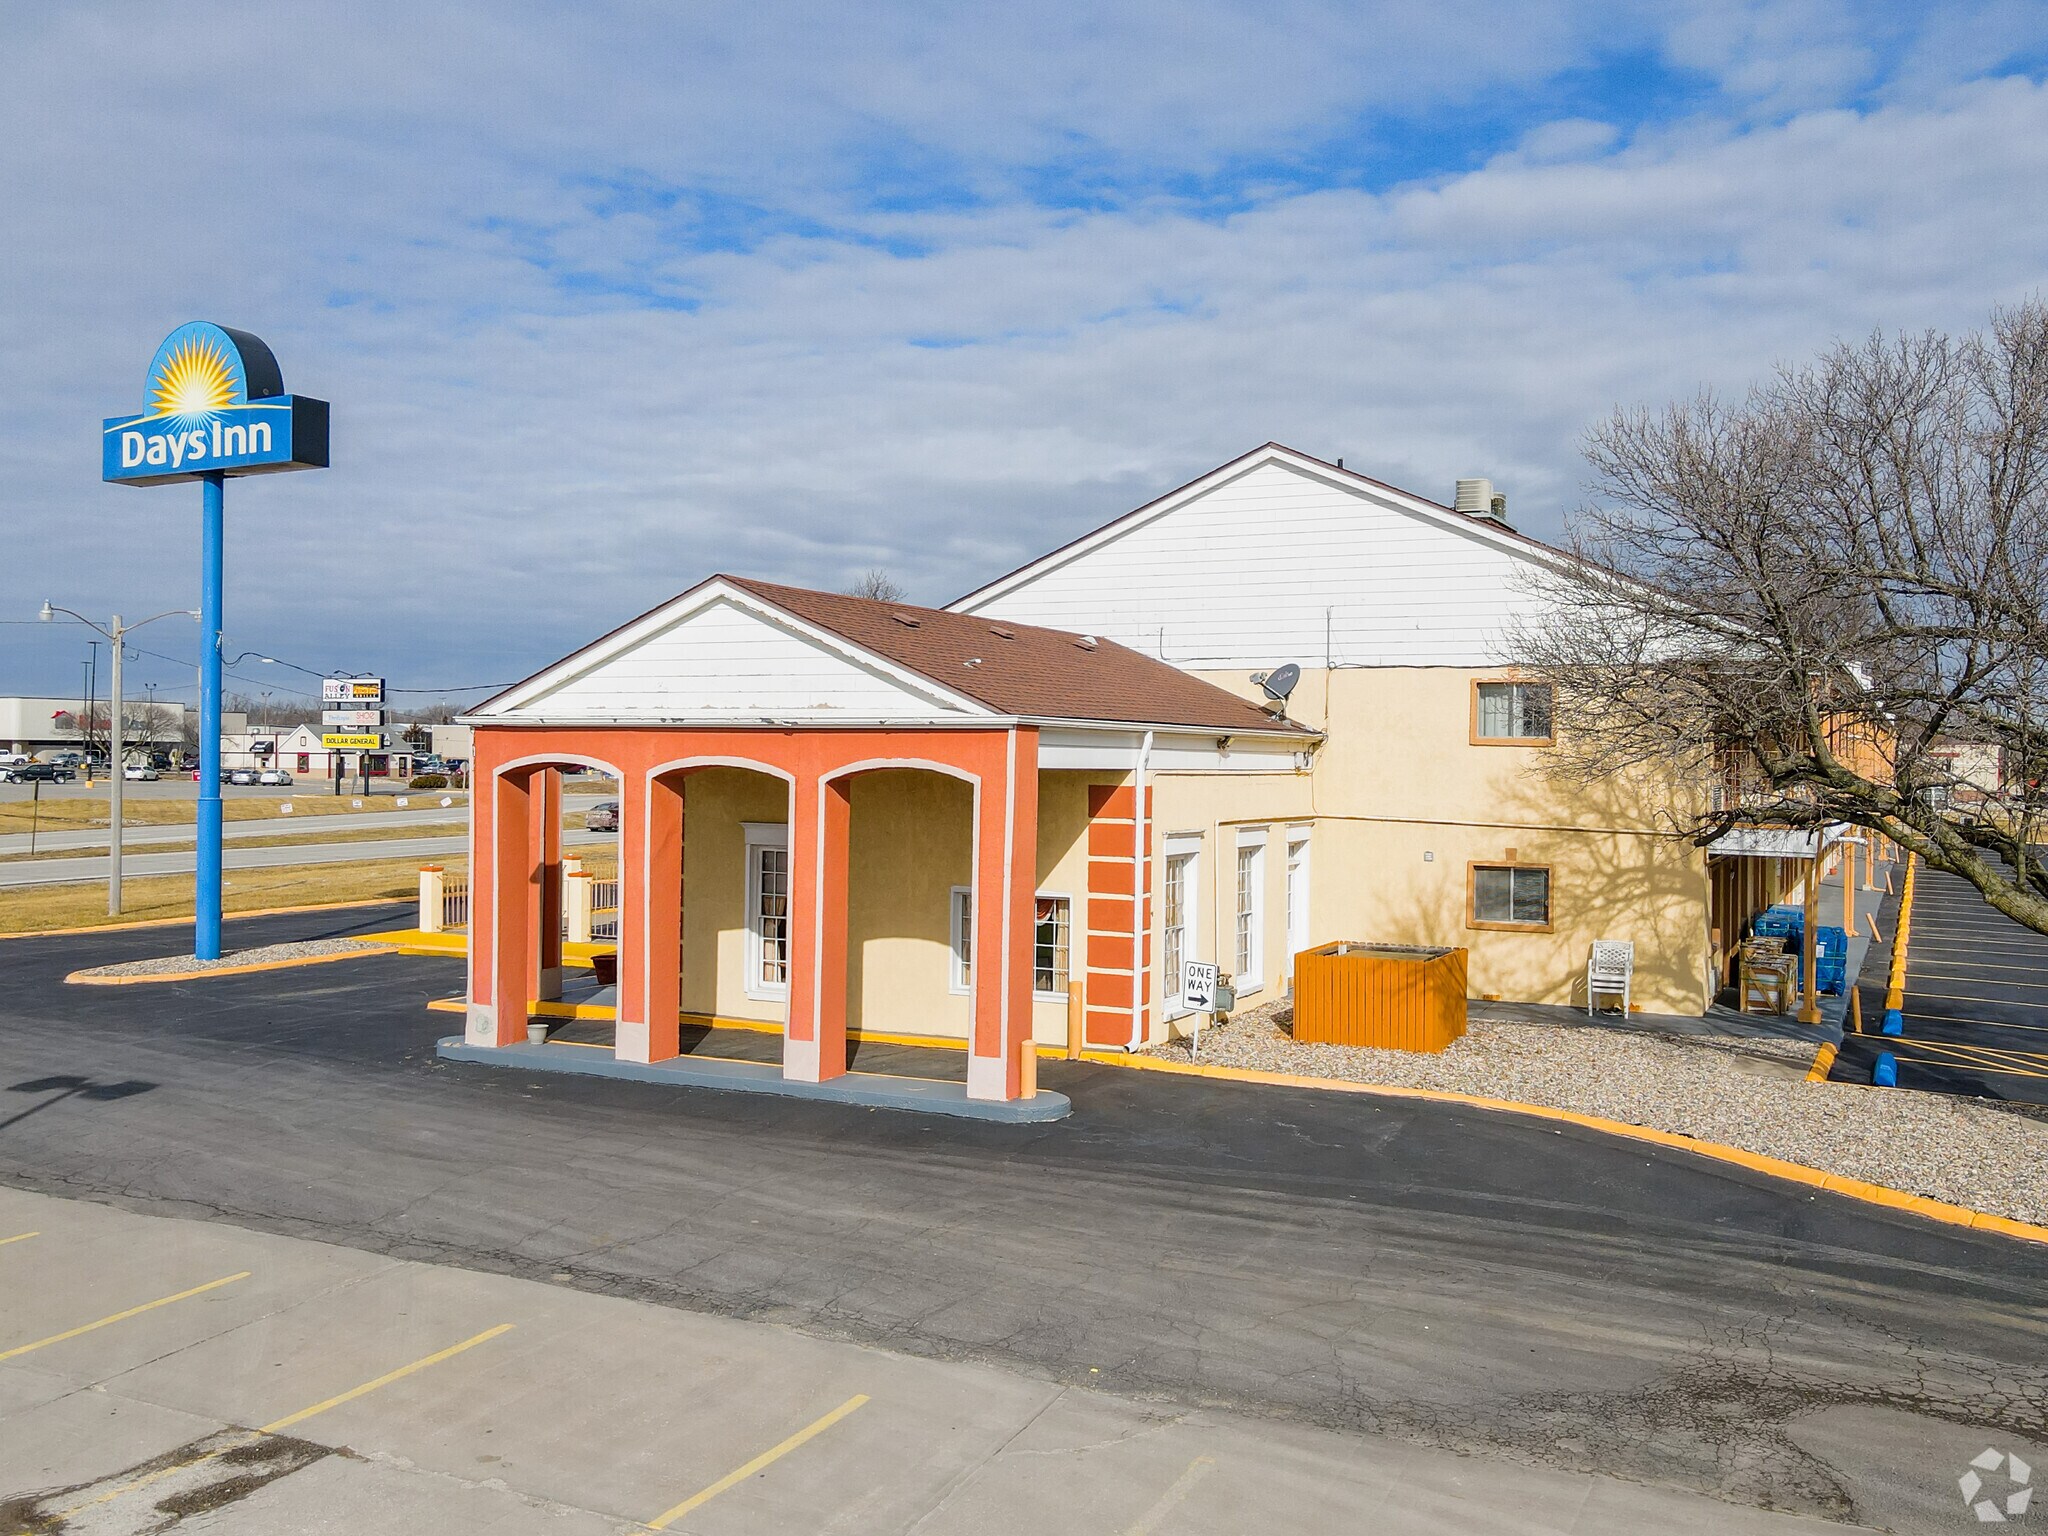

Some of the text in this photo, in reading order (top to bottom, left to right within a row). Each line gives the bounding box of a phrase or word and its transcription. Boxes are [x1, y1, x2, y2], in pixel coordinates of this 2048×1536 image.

[121, 420, 272, 468] Days Inn
[326, 737, 349, 745] DOLLAR
[1188, 965, 1213, 980] ONE
[1188, 979, 1212, 992] WAY
